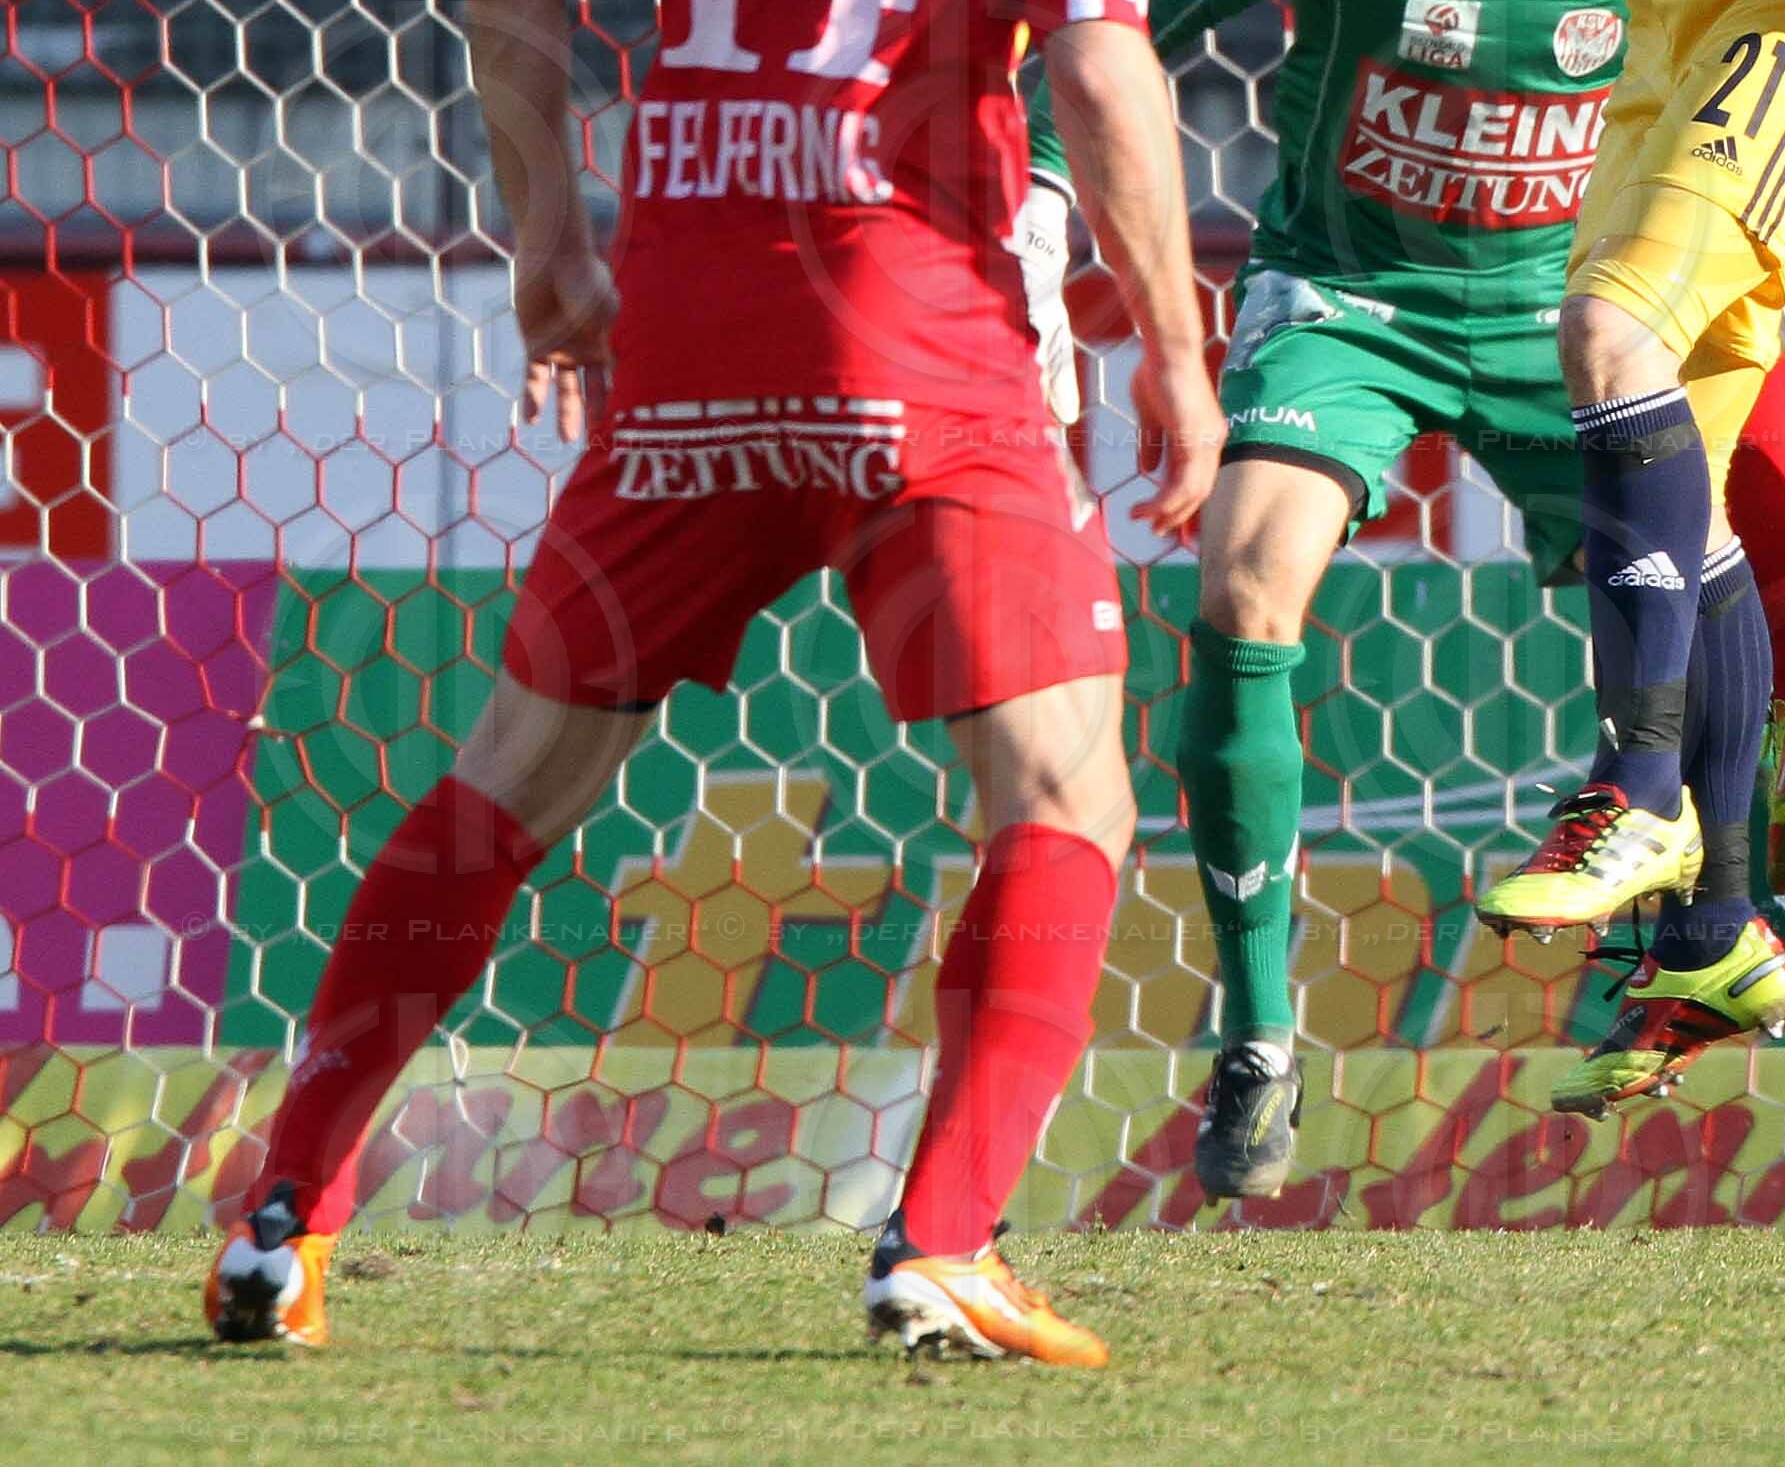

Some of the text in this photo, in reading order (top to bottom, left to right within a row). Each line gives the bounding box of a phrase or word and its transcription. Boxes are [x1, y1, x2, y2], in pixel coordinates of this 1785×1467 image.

[1407, 45, 1465, 70] LIGA
[1360, 73, 1609, 157] KLEIN
[1691, 147, 1743, 176] adidas
[609, 442, 906, 501] ZEITUNG
[1607, 574, 1686, 590] adidas
